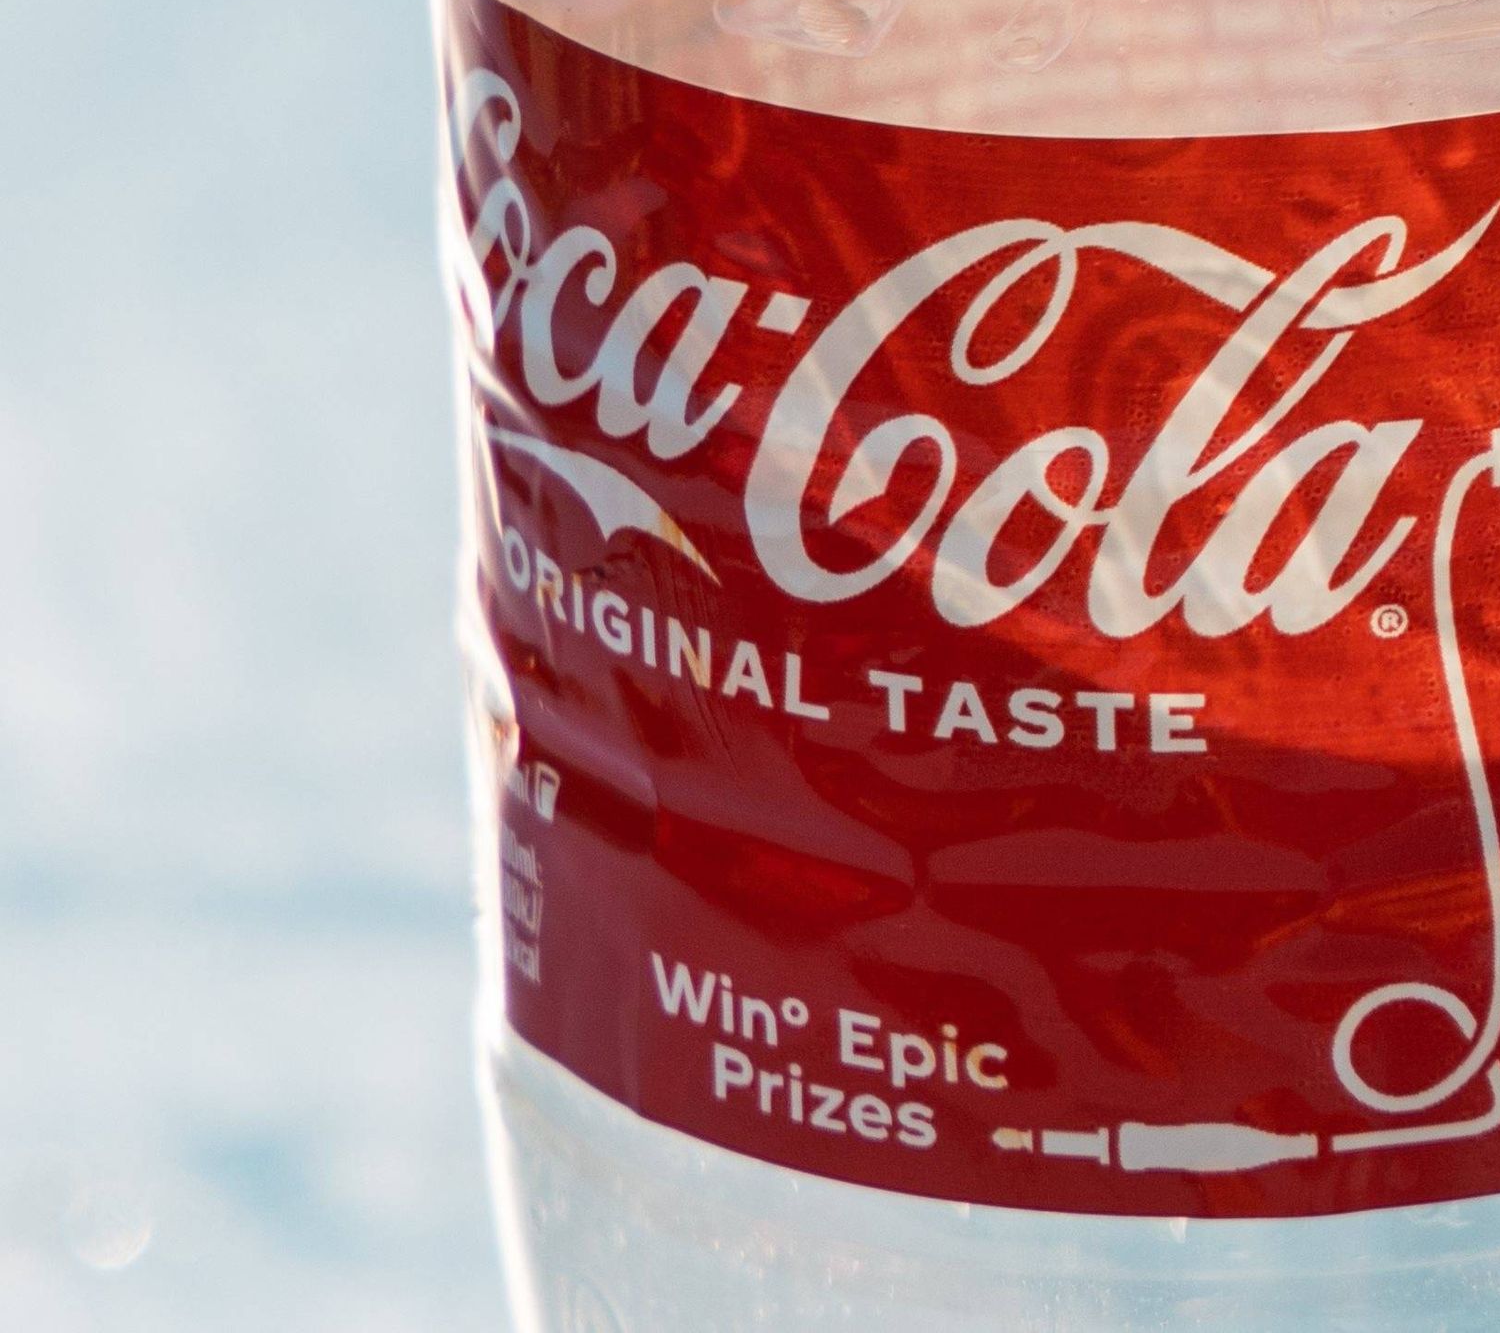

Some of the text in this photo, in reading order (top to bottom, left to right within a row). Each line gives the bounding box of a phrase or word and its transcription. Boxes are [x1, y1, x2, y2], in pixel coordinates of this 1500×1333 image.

[501, 524, 1206, 754] ORIGINAL TASTE
[711, 1042, 938, 1149] Prizes
[837, 1007, 1010, 1090] Epic
